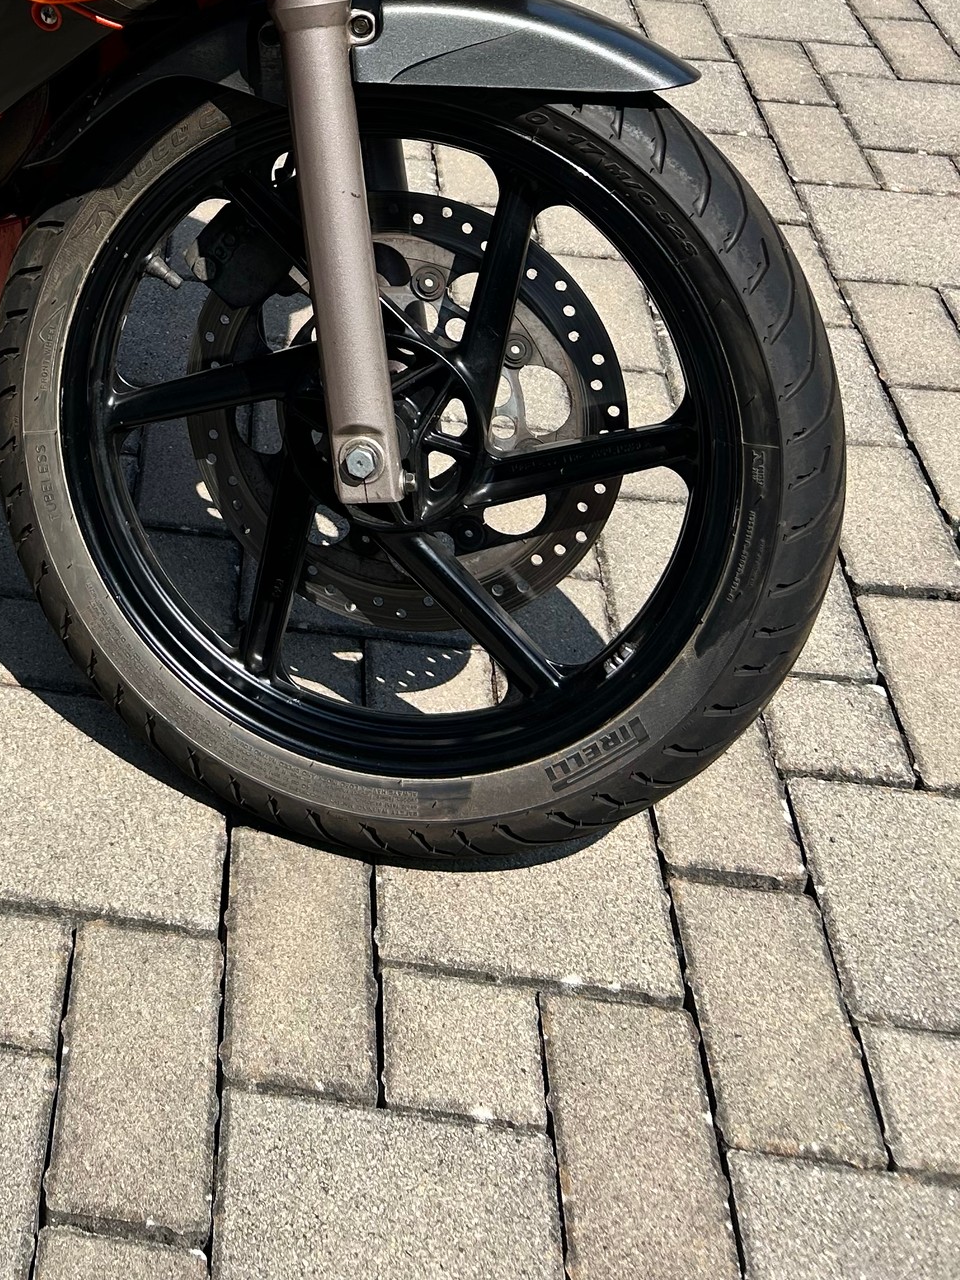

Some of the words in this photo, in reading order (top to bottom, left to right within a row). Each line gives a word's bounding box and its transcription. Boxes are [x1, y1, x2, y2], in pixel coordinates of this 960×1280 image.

[44, 324, 56, 356] WHEEL
[40, 358, 51, 391] FRONT
[34, 445, 62, 522] TUBELESS
[544, 716, 651, 792] PIRELLI
